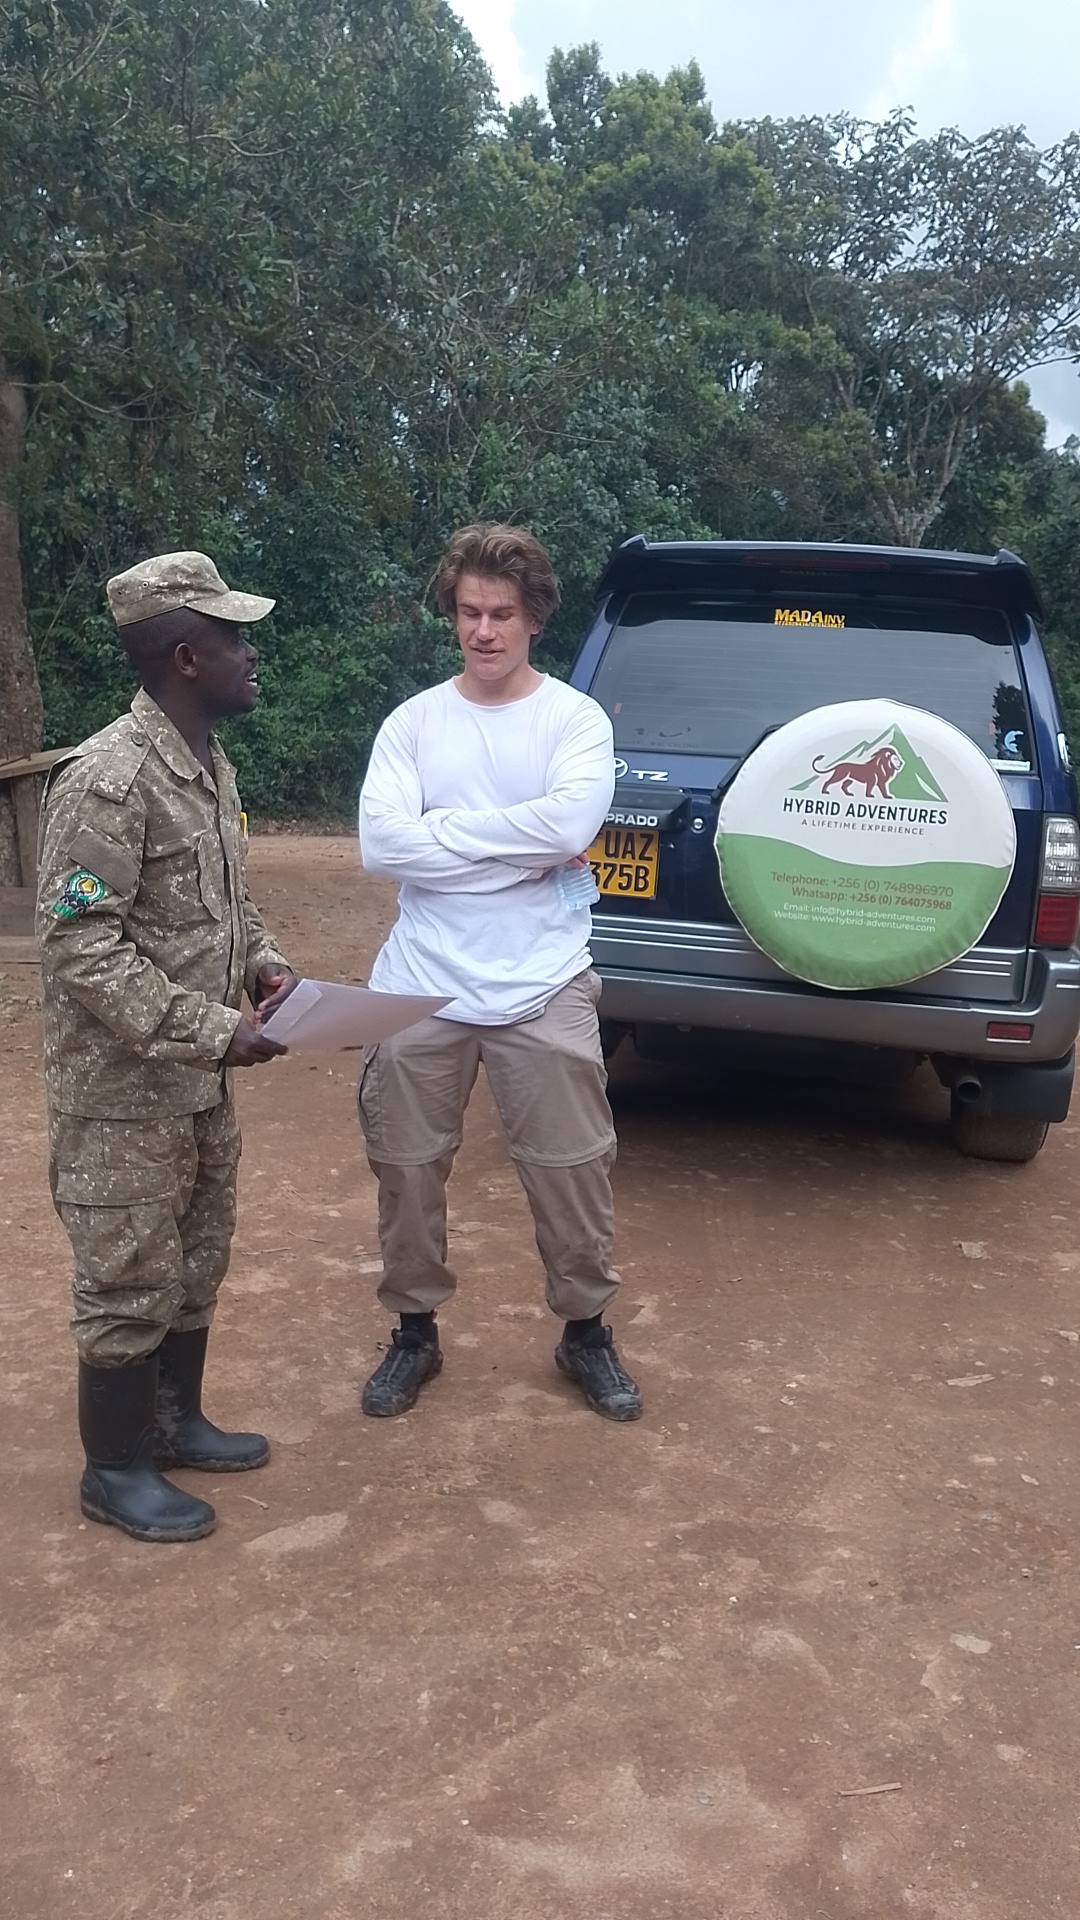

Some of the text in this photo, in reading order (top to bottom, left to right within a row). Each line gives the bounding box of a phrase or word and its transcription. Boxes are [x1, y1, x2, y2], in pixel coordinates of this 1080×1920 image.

[631, 769, 669, 782] TZ
[605, 813, 658, 827] PRADO
[783, 797, 948, 825] HYBRID ADVENTURES
[811, 820, 858, 831] LIFETIME
[861, 823, 925, 836] EXPERIENCE
[604, 830, 654, 862] UAZ
[590, 861, 650, 893] 375B
[771, 871, 829, 887] Telephone:
[831, 876, 862, 890] +256
[864, 879, 880, 893] (0)
[792, 885, 952, 911] Whatsapp: +256 (0) 764075968
[774, 910, 936, 933] Website: www.hybrid-adventures.com
[783, 902, 937, 924] Email: info@hybrid-adventures.com
